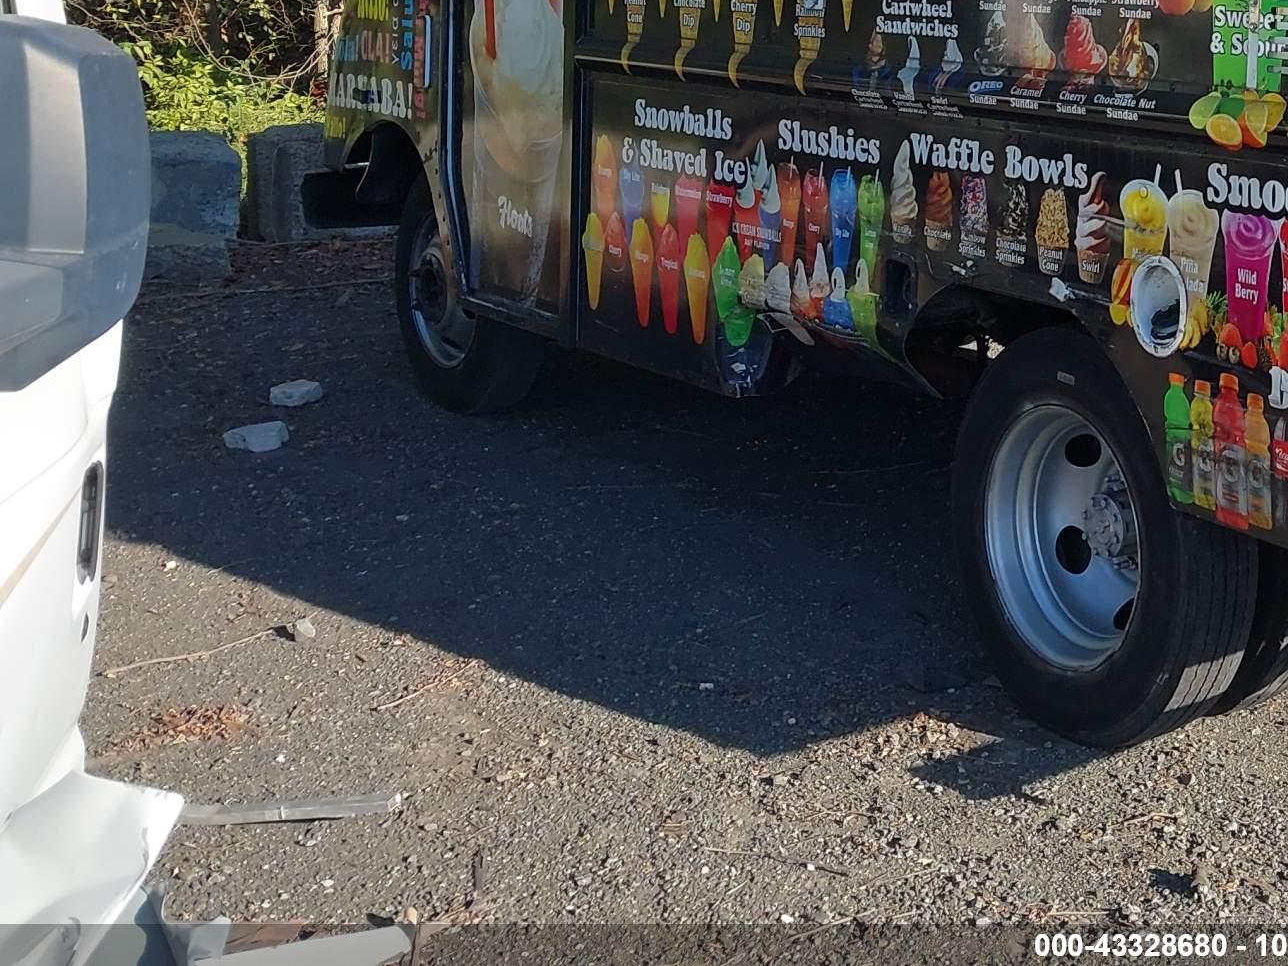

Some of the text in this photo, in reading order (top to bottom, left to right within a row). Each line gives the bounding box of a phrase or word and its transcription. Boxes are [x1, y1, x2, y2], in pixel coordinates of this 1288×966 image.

[730, 0, 757, 15] Cherry
[979, 0, 1007, 11] Sundae
[1022, 3, 1051, 14] Sundae
[1072, 5, 1102, 17] Sundae
[684, 14, 695, 27] Dip
[1119, 8, 1152, 19] Sundae
[736, 18, 750, 33] Dip
[794, 24, 825, 38] Sprinkles
[876, 16, 959, 38] Sandwiches
[1210, 36, 1225, 55] &
[970, 81, 1003, 92] OREO
[1010, 85, 1043, 97] Caramel
[970, 94, 997, 105] Sundae
[1010, 97, 1039, 110] Sundae
[1059, 90, 1088, 104] Cherry
[1093, 93, 1156, 109] Chocolate Nut
[1056, 103, 1086, 115] Sundae
[1106, 107, 1138, 121] Sundae
[635, 98, 732, 141] Snowballs
[778, 119, 880, 164] Slushies
[622, 137, 746, 184] & Shaved Ice
[911, 133, 1088, 189] Waffle Bowls
[996, 238, 1026, 252] Chocolate
[995, 251, 1024, 265] Sprinkles
[1039, 247, 1062, 260] Peanut
[1041, 260, 1058, 272] Cone
[1082, 261, 1100, 272] Swirl
[1237, 268, 1257, 285] Wild
[1235, 284, 1259, 304] Berry
